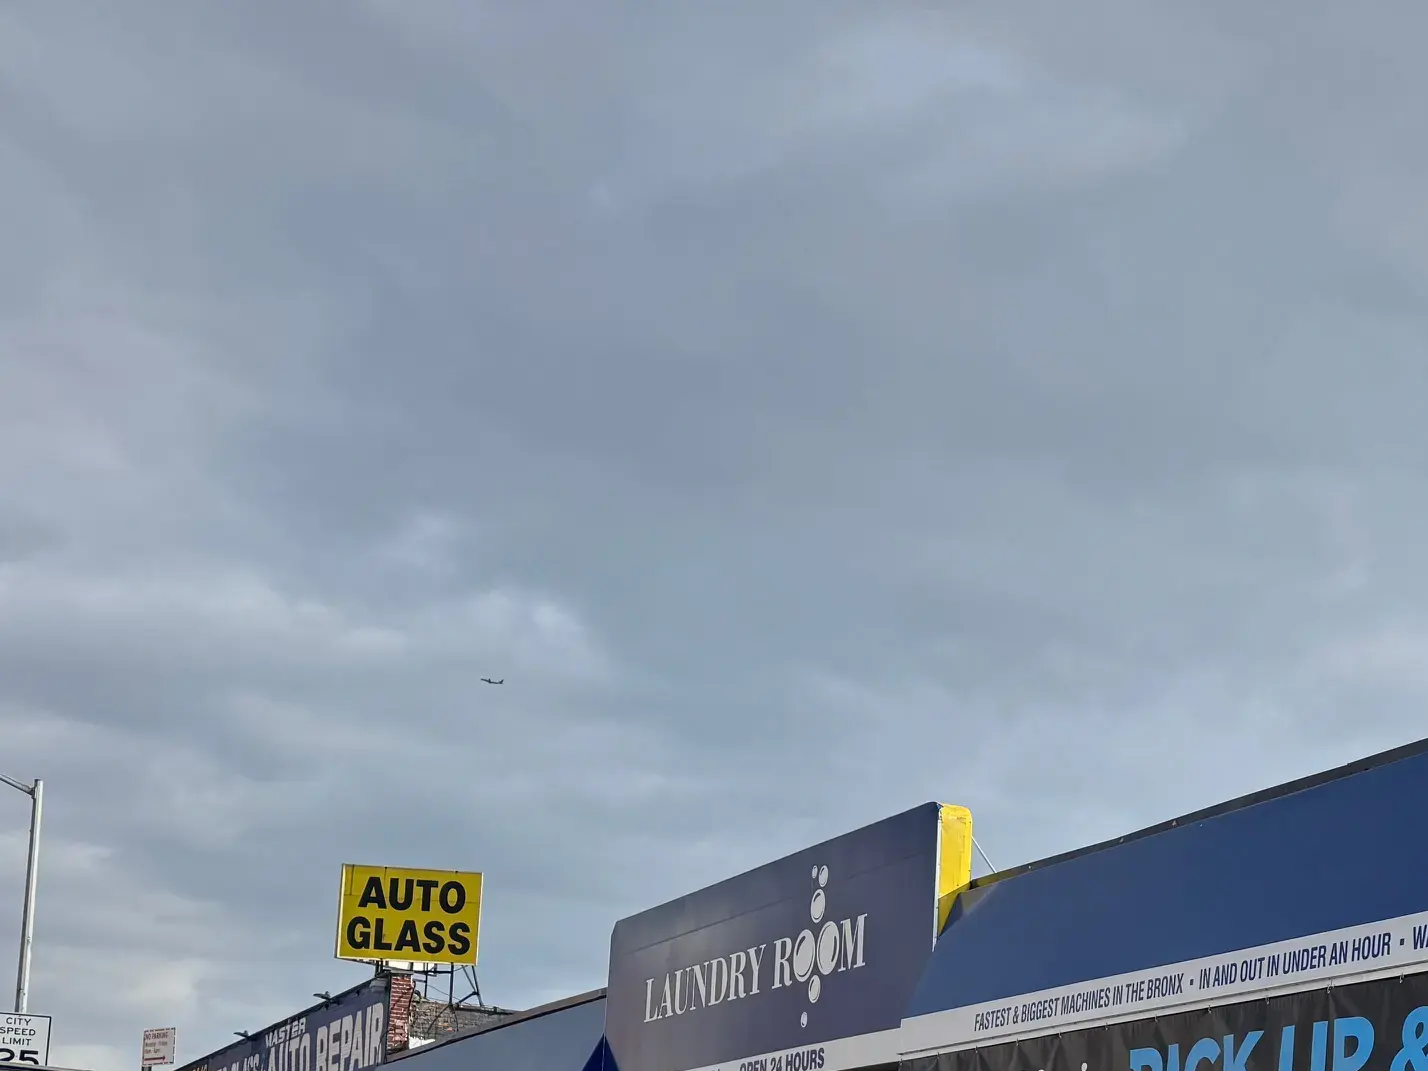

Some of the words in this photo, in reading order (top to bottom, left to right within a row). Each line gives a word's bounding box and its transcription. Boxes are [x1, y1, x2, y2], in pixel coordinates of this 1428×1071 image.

[357, 876, 466, 914] AUTO
[346, 916, 471, 955] GLASS
[643, 944, 767, 1023] LAUNDRY
[771, 913, 867, 989] ROOM
[974, 1006, 1012, 1031] FASTEST
[1012, 1006, 1019, 1024] &
[1021, 997, 1060, 1023] BIGGEST
[1060, 987, 1111, 1016] MACHINES
[1112, 985, 1123, 1006] IN
[1125, 980, 1146, 1003] THE
[1146, 973, 1184, 1000] BRONX
[1199, 967, 1210, 990] IN
[1213, 962, 1237, 987] AND
[1240, 957, 1266, 983] OUT
[1266, 953, 1280, 977] IN
[1282, 944, 1327, 974] UNDER
[1329, 940, 1348, 965] AN
[1351, 932, 1391, 962] HOUR
[0, 1026, 36, 1036] SPEED
[6, 1017, 32, 1026] CITY
[2, 1037, 32, 1046] LIMIT
